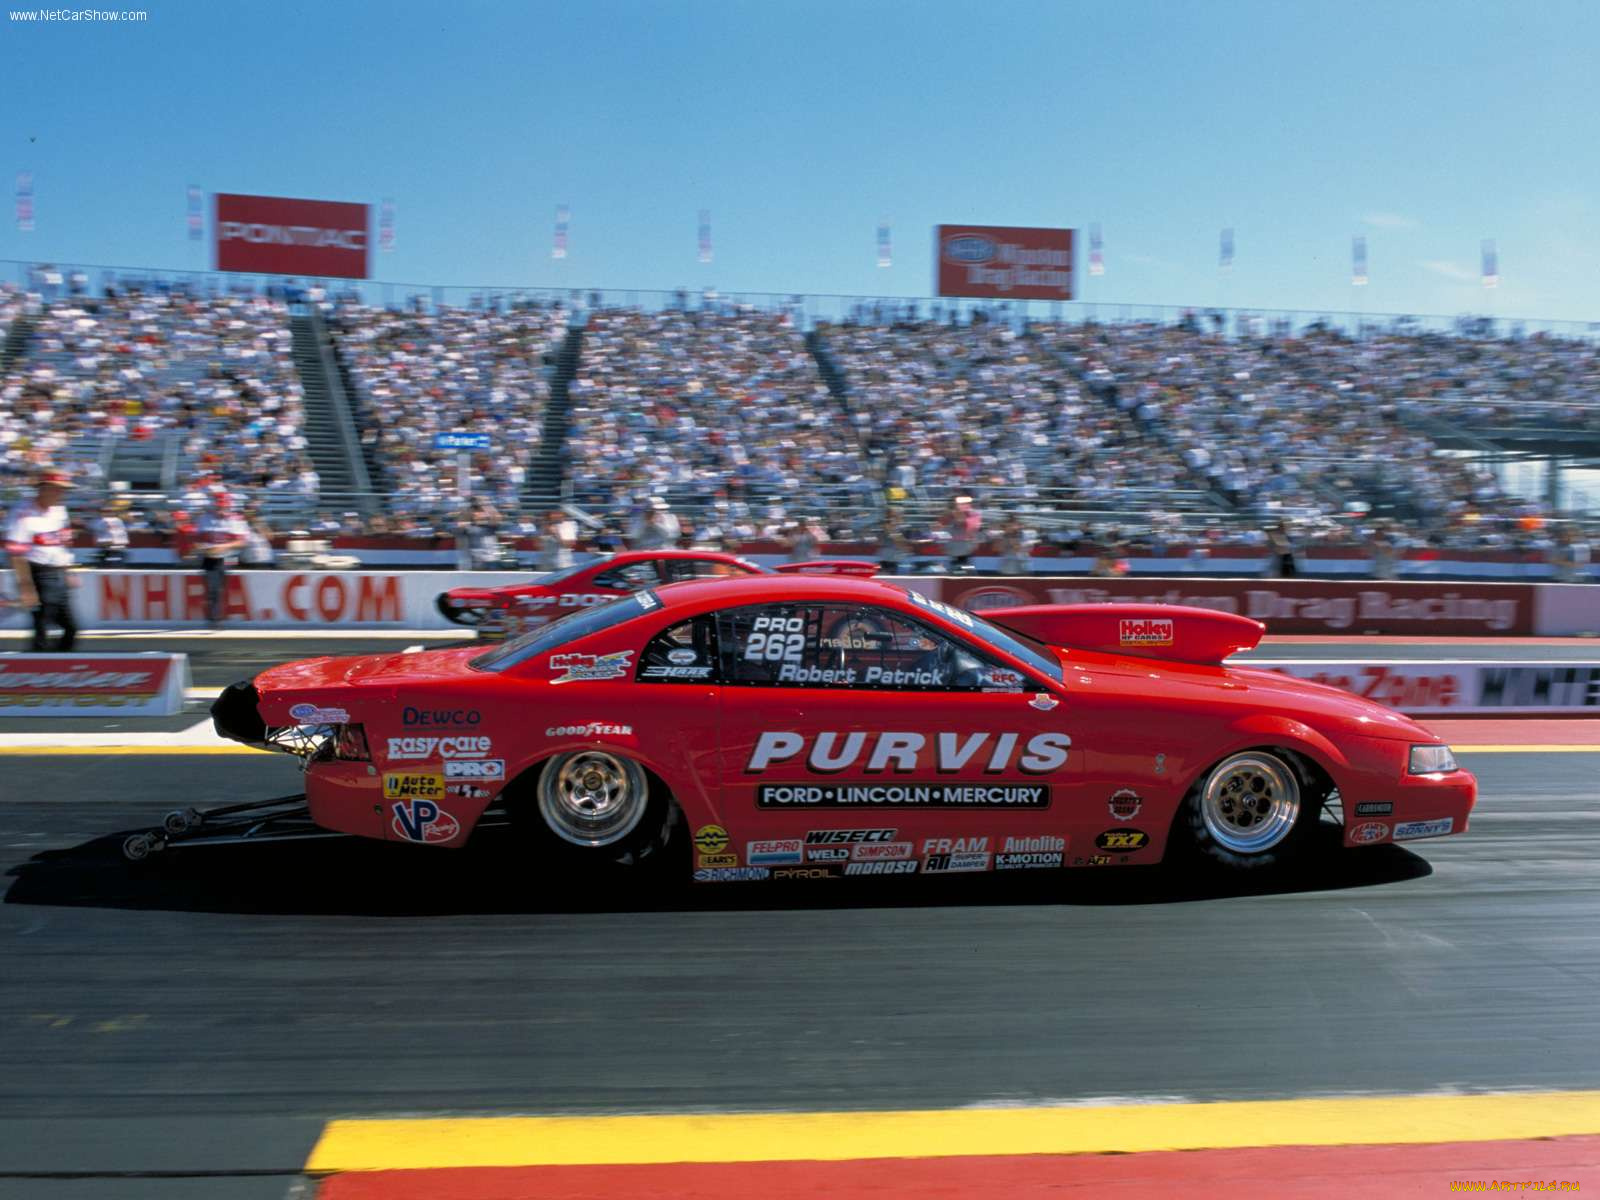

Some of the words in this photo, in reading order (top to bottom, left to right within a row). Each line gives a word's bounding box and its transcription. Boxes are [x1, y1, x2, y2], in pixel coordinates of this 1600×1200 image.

[218, 220, 368, 250] PONTIAC
[1245, 590, 1356, 628] Drag
[1357, 591, 1520, 630] Racing
[753, 617, 804, 632] PRO
[1121, 620, 1172, 639] Holley
[744, 633, 806, 661] 262
[779, 663, 857, 684] Robert
[864, 666, 944, 686] Patrick
[747, 731, 1072, 774] PURVIS
[445, 760, 502, 777] PRO
[402, 775, 437, 786] Auto
[400, 785, 443, 797] Meter
[763, 787, 823, 803] FORD
[837, 787, 930, 803] LINCOLN
[943, 787, 1043, 803] MERCURY
[393, 799, 439, 841] VP
[1395, 821, 1450, 836] SONNY'S
[856, 845, 907, 857] SIMPSON
[922, 837, 988, 853] FRAM
[1004, 836, 1065, 852] Autolite
[807, 849, 849, 860] WELD
[996, 853, 1062, 864] K-MOTION
[774, 869, 838, 880] PYROIL
[845, 860, 919, 876] MOROSO
